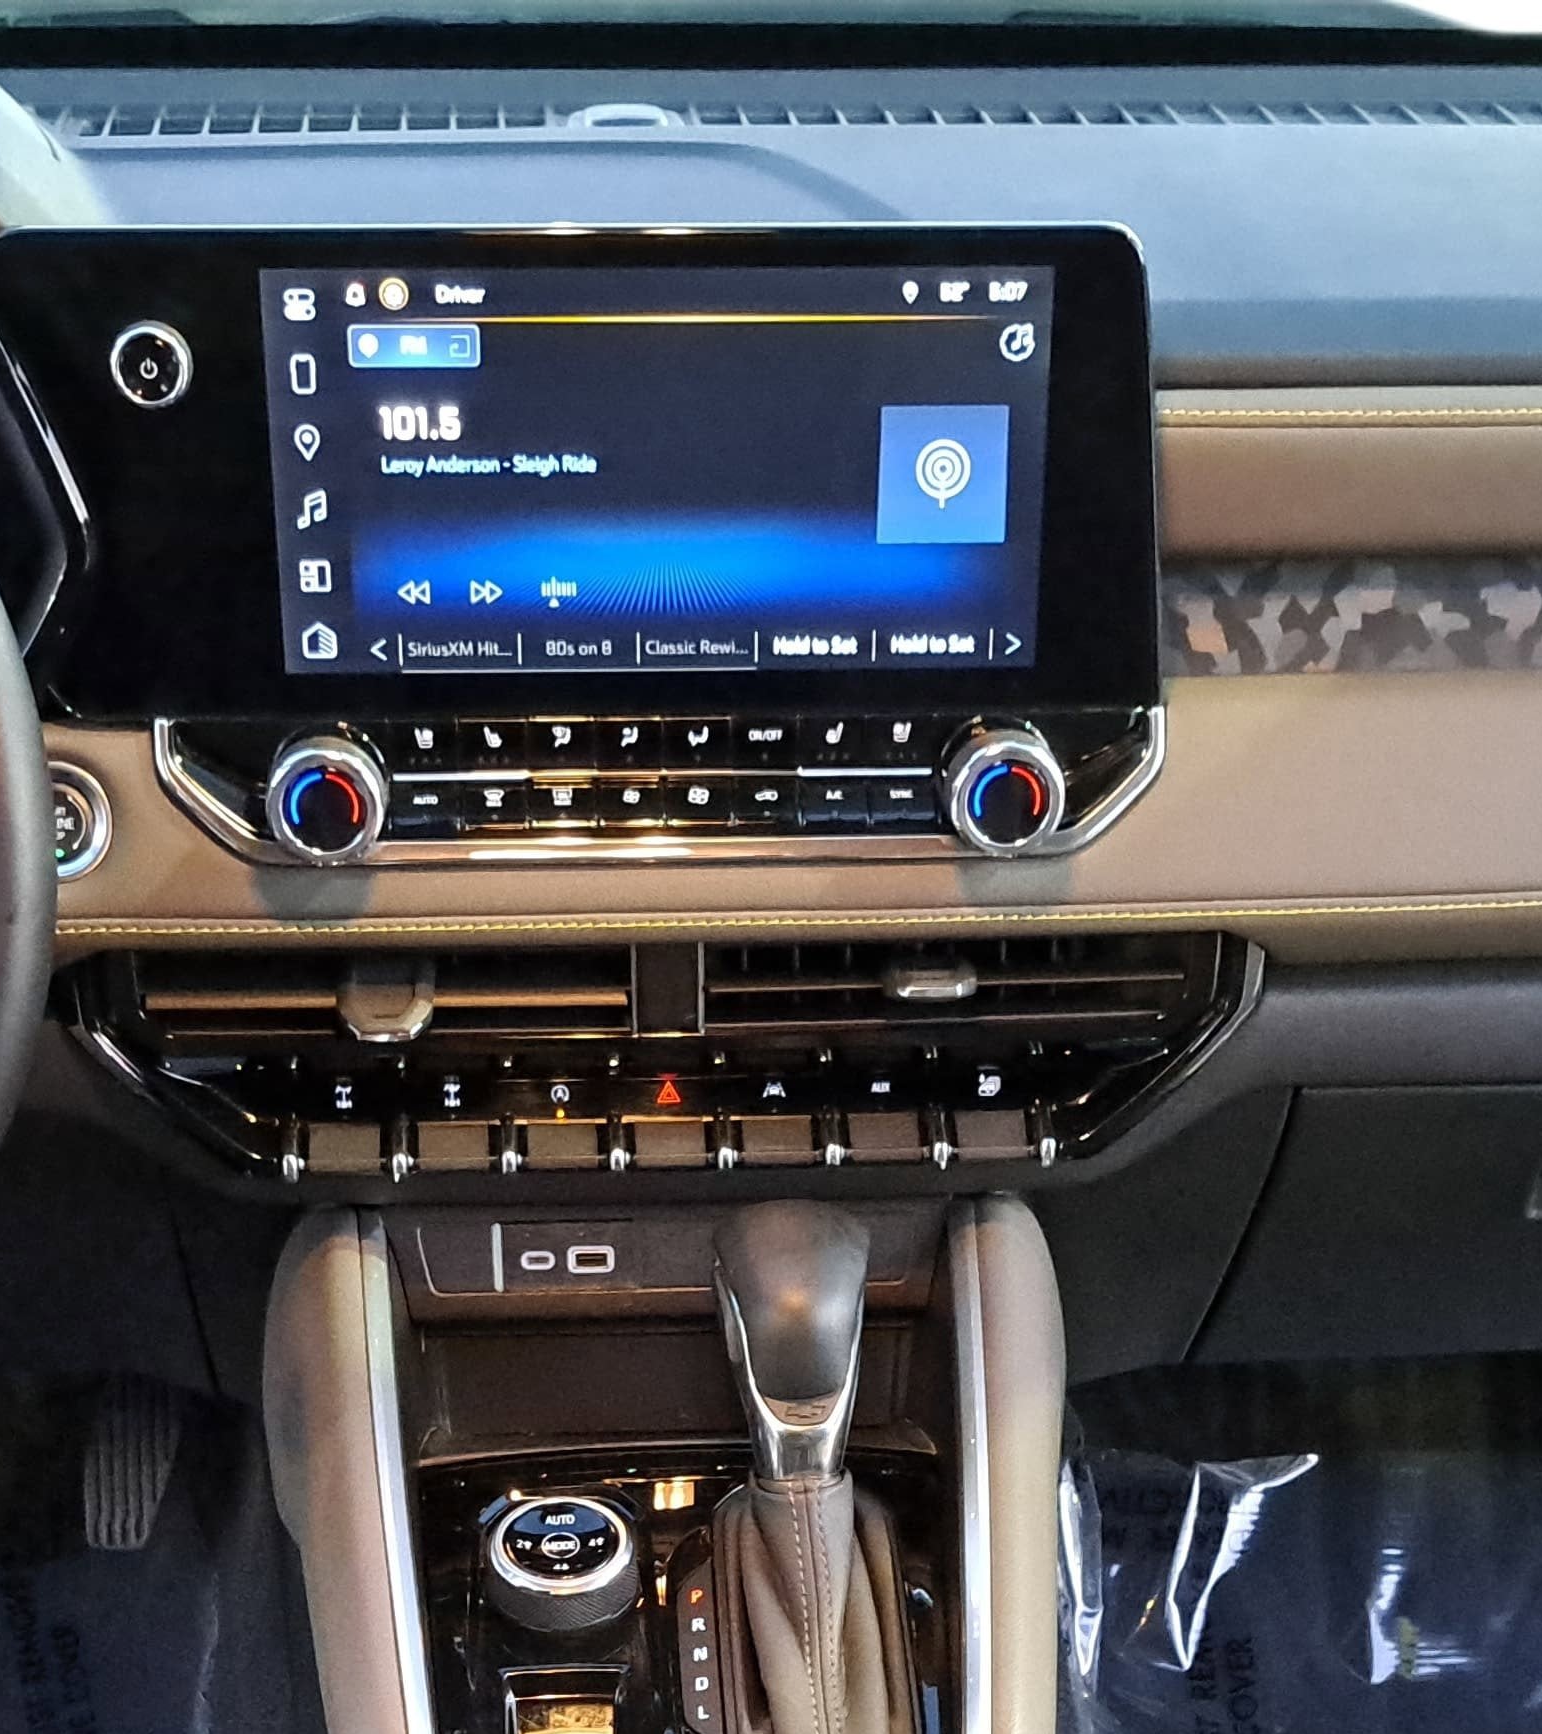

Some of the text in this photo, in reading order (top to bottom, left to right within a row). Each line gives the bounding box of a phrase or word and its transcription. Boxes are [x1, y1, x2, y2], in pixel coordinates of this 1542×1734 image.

[434, 284, 486, 305] Driver
[378, 405, 461, 441] 101.5
[380, 454, 425, 478] Leroy
[426, 454, 501, 475] Anderson
[512, 454, 559, 478] Sleigh
[562, 454, 597, 475] Ride
[407, 640, 474, 658] SiriusXM
[545, 640, 612, 657] 80s on 8
[645, 639, 697, 656] Classic
[772, 634, 858, 656] Hold to Set
[890, 633, 976, 655] Hold to Set
[748, 728, 784, 744] ON/OFF
[413, 795, 438, 806] AUTO
[545, 1513, 576, 1526] AUTO
[545, 1540, 576, 1551] MODE
[690, 1589, 704, 1604] P
[691, 1617, 706, 1632] R
[693, 1646, 708, 1662] N
[695, 1676, 709, 1692] D
[697, 1705, 709, 1720] L
